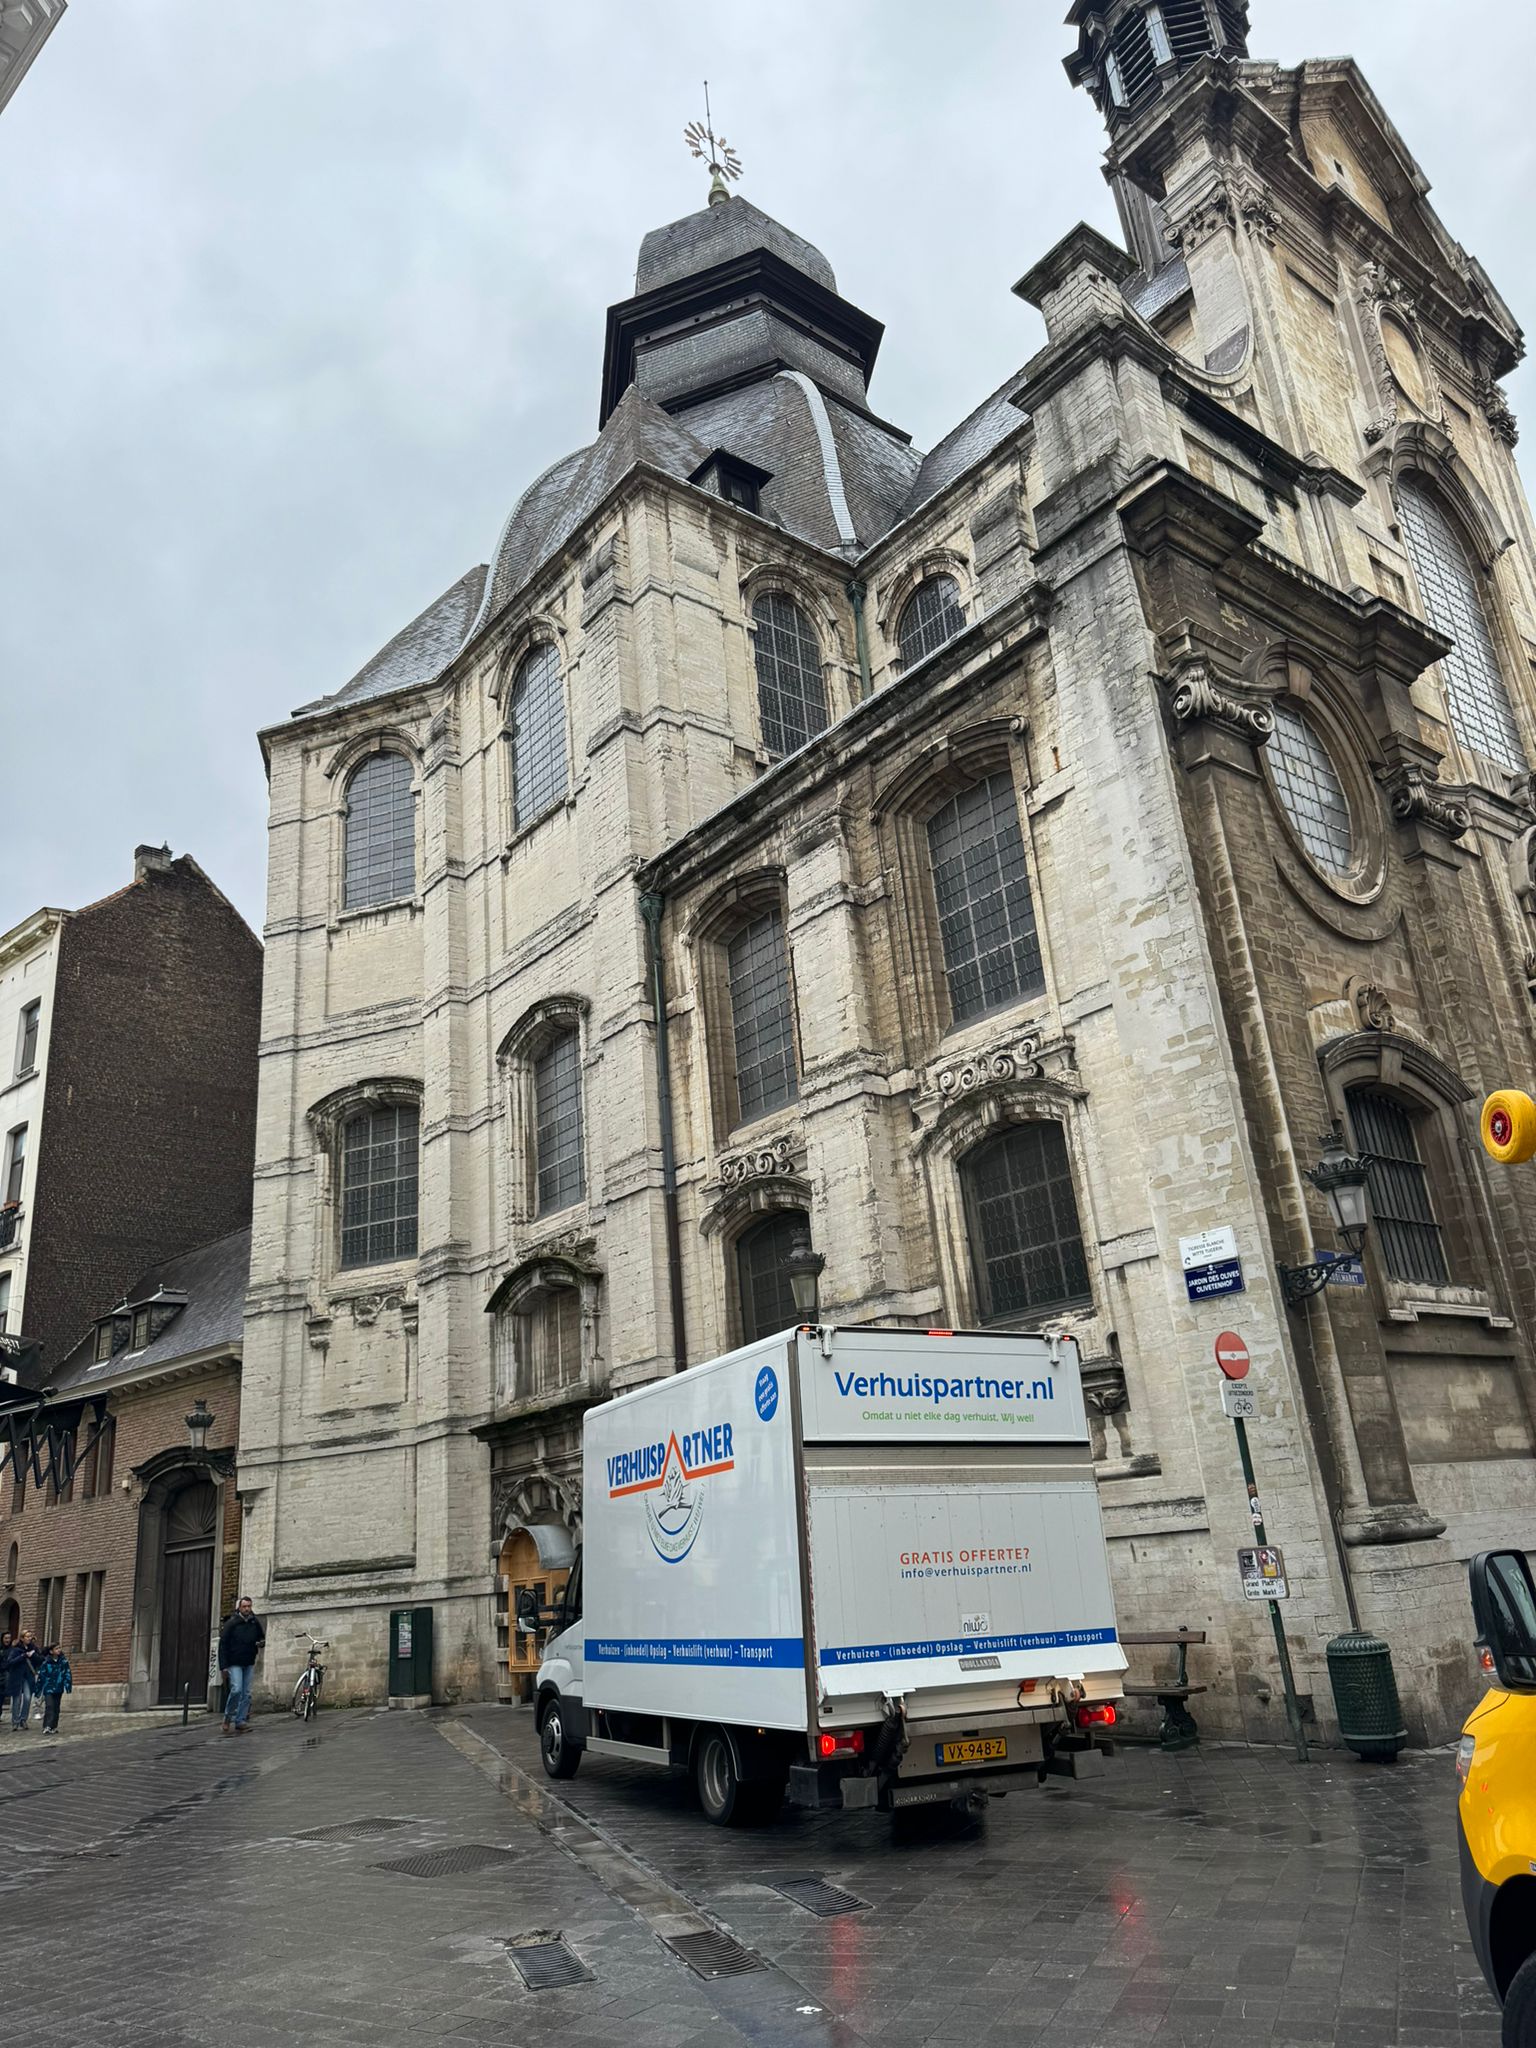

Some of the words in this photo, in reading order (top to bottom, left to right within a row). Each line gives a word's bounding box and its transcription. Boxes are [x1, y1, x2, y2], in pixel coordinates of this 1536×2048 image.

[1188, 1277, 1208, 1287] JARDIN
[1208, 1274, 1220, 1282] DES
[1220, 1270, 1240, 1280] OLIVES
[1196, 1279, 1233, 1293] OLIVETENHOF
[834, 1371, 1054, 1404] Verhuispartner.nl
[862, 1411, 893, 1420] Omdat
[904, 1411, 922, 1420] niet
[924, 1412, 942, 1420] elke
[944, 1412, 961, 1423] dag
[1000, 1413, 1015, 1424] Wij
[900, 1551, 954, 1564] GRATIS
[959, 1548, 1030, 1562] OFFERTE?
[901, 1563, 1032, 1578] info@verhuispartner.nl
[1262, 1588, 1276, 1596] Markt
[598, 1644, 620, 1656] Verhuizen
[650, 1644, 667, 1660] Opslag
[673, 1644, 703, 1658] Verhuislift
[704, 1644, 733, 1659] (verhuur)
[740, 1644, 773, 1661] Transport
[836, 1648, 880, 1660] Verhuizen
[888, 1644, 933, 1658] (inboedel)
[936, 1642, 964, 1654] Opslag
[973, 1638, 1018, 1650] Verhuislift
[1020, 1634, 1057, 1648] (verhuur)
[1066, 1632, 1103, 1643] Transport
[948, 1741, 1002, 1760] VX-948-Z
